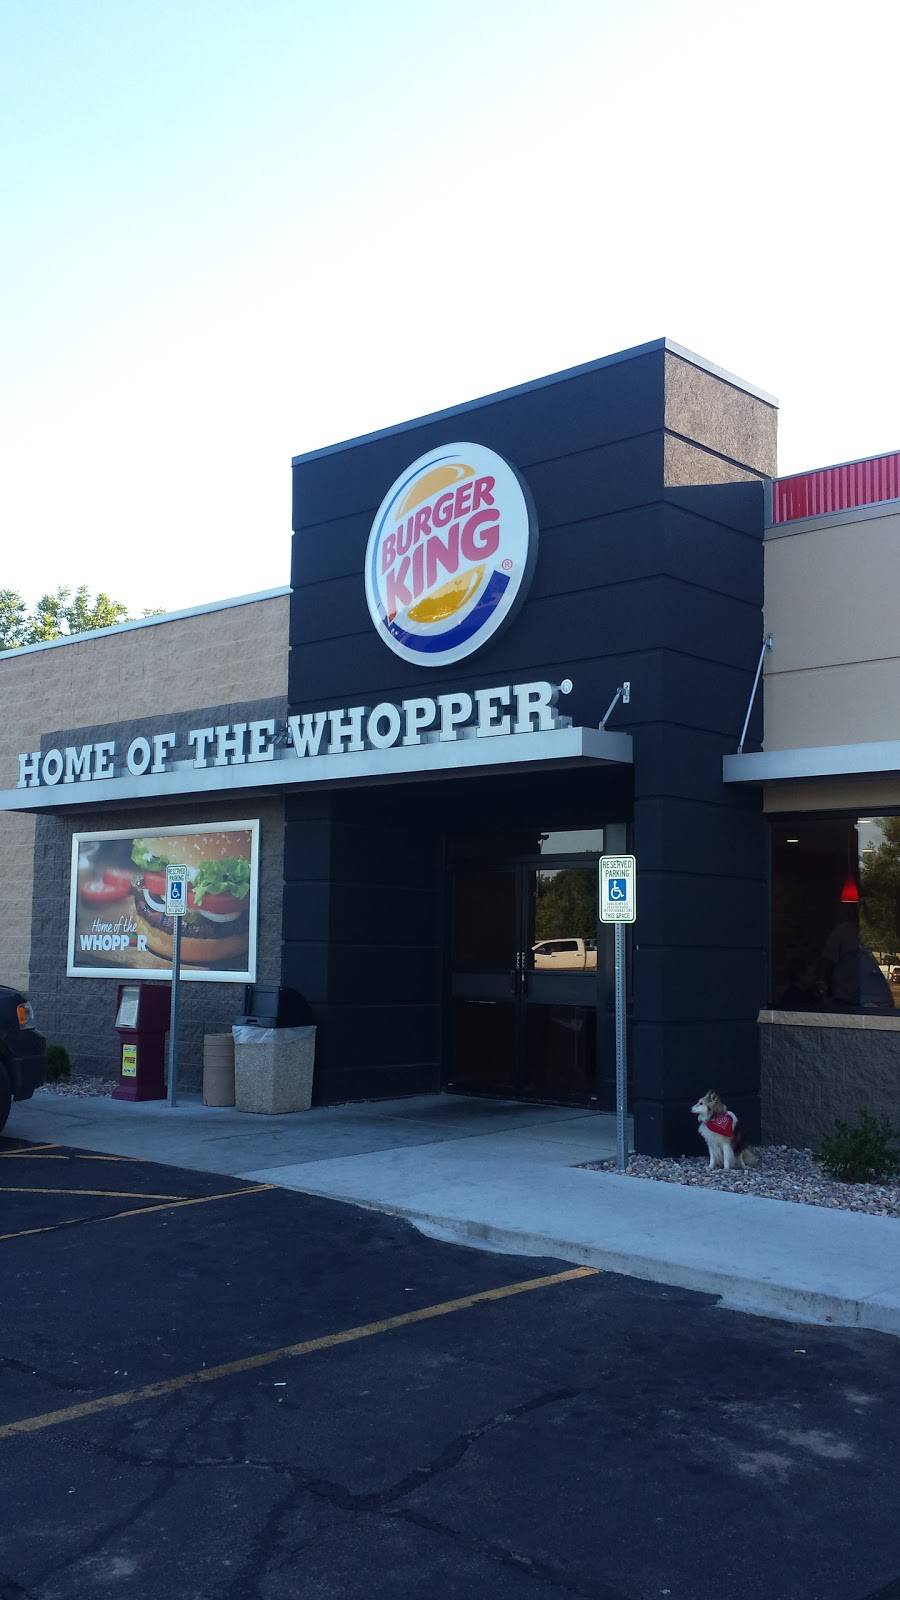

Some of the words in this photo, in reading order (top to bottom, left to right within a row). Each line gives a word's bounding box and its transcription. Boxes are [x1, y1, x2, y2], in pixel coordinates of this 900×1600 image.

[381, 475, 496, 574] BURGER
[382, 508, 501, 626] KING
[16, 740, 116, 789] HOME
[125, 732, 176, 777] OF
[187, 719, 276, 769] THE
[286, 680, 559, 758] WHOPPER
[602, 860, 632, 869] RESERVED
[605, 869, 630, 878] PARKING
[92, 917, 113, 933] Home
[113, 915, 123, 934] of
[123, 916, 137, 933] the
[80, 934, 148, 951] WHOPPR
